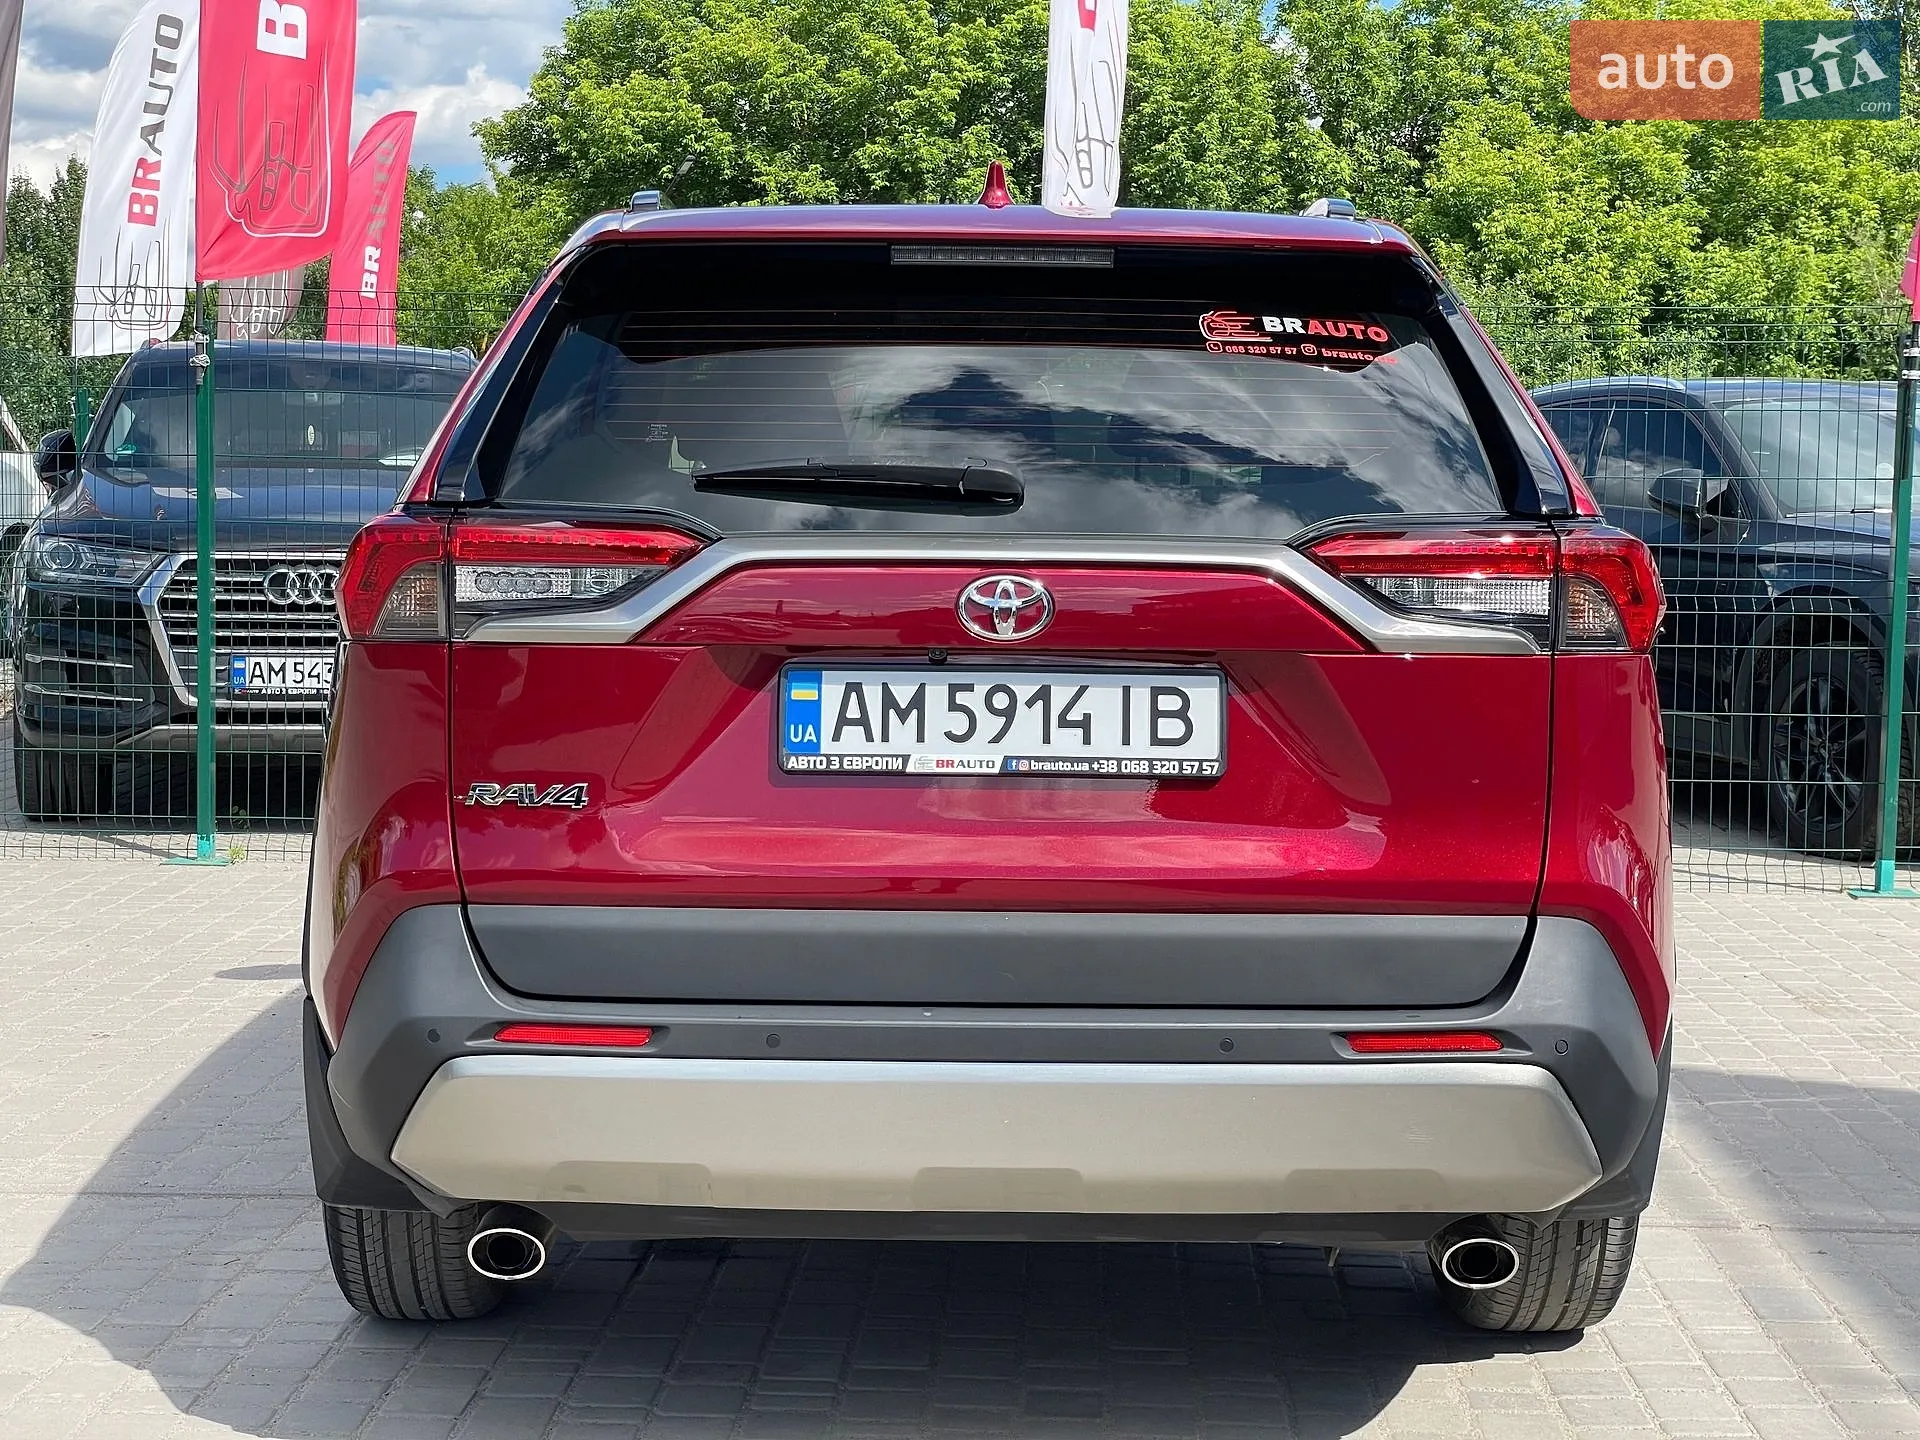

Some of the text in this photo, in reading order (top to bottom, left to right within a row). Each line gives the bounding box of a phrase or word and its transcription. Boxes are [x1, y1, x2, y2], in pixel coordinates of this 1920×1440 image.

[127, 13, 184, 227] BRAUTO
[361, 139, 396, 300] BRAUTO
[1262, 316, 1389, 343] BRAUTO
[1247, 346, 1267, 354] 320
[1269, 346, 1282, 355] 57
[1284, 347, 1297, 356] 57
[233, 676, 246, 685] UA
[248, 661, 286, 685] AM
[831, 682, 1195, 747] AM 5914 IB
[789, 724, 818, 744] UA
[787, 756, 827, 769] АВТО
[843, 756, 904, 770] ЄВРОПИ
[935, 759, 996, 769] BRAUTO
[1030, 760, 1220, 775] brauto.ua +38 068 320 57 57
[465, 783, 589, 808] RAV4
